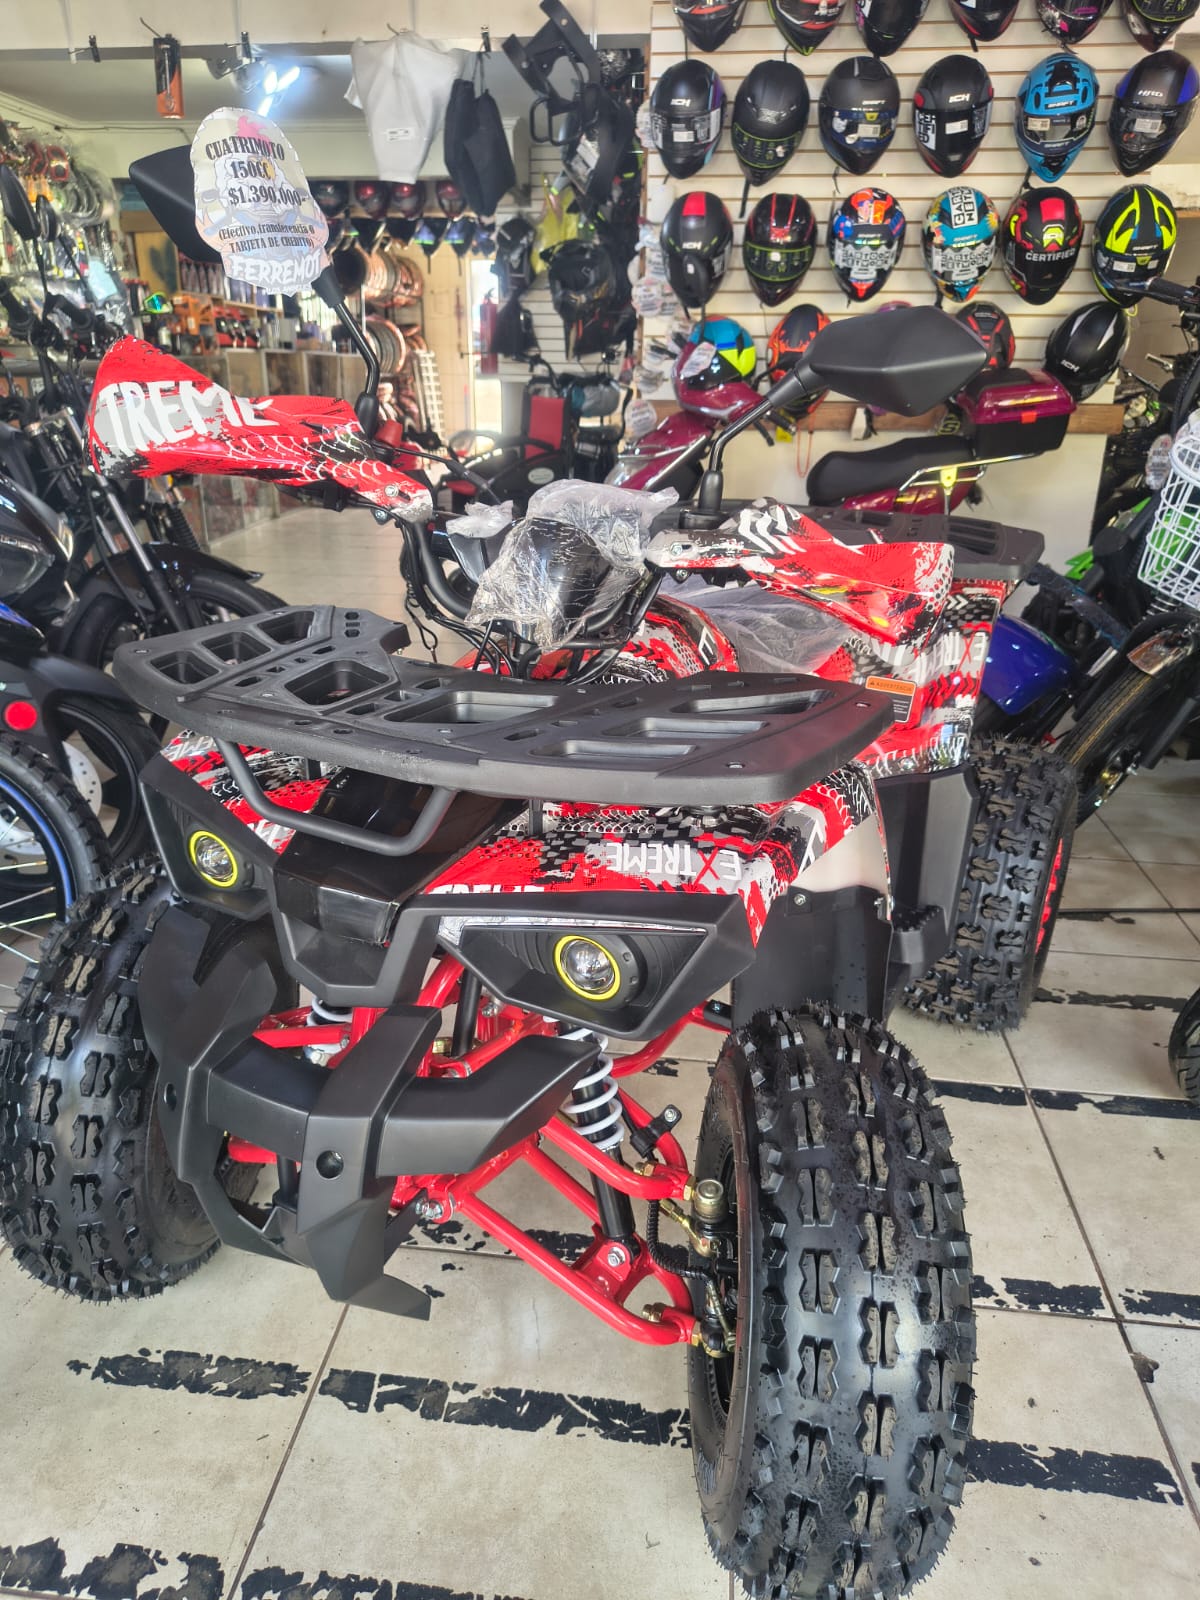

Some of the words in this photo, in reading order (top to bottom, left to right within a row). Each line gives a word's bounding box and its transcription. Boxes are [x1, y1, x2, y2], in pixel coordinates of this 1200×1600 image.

[205, 136, 285, 161] CUATRIMOTO
[230, 160, 272, 180] 150CC
[229, 237, 268, 254] TARJETA
[268, 236, 280, 248] DE
[1025, 247, 1076, 263] CERTIFIED
[605, 841, 742, 885] EXTREME
